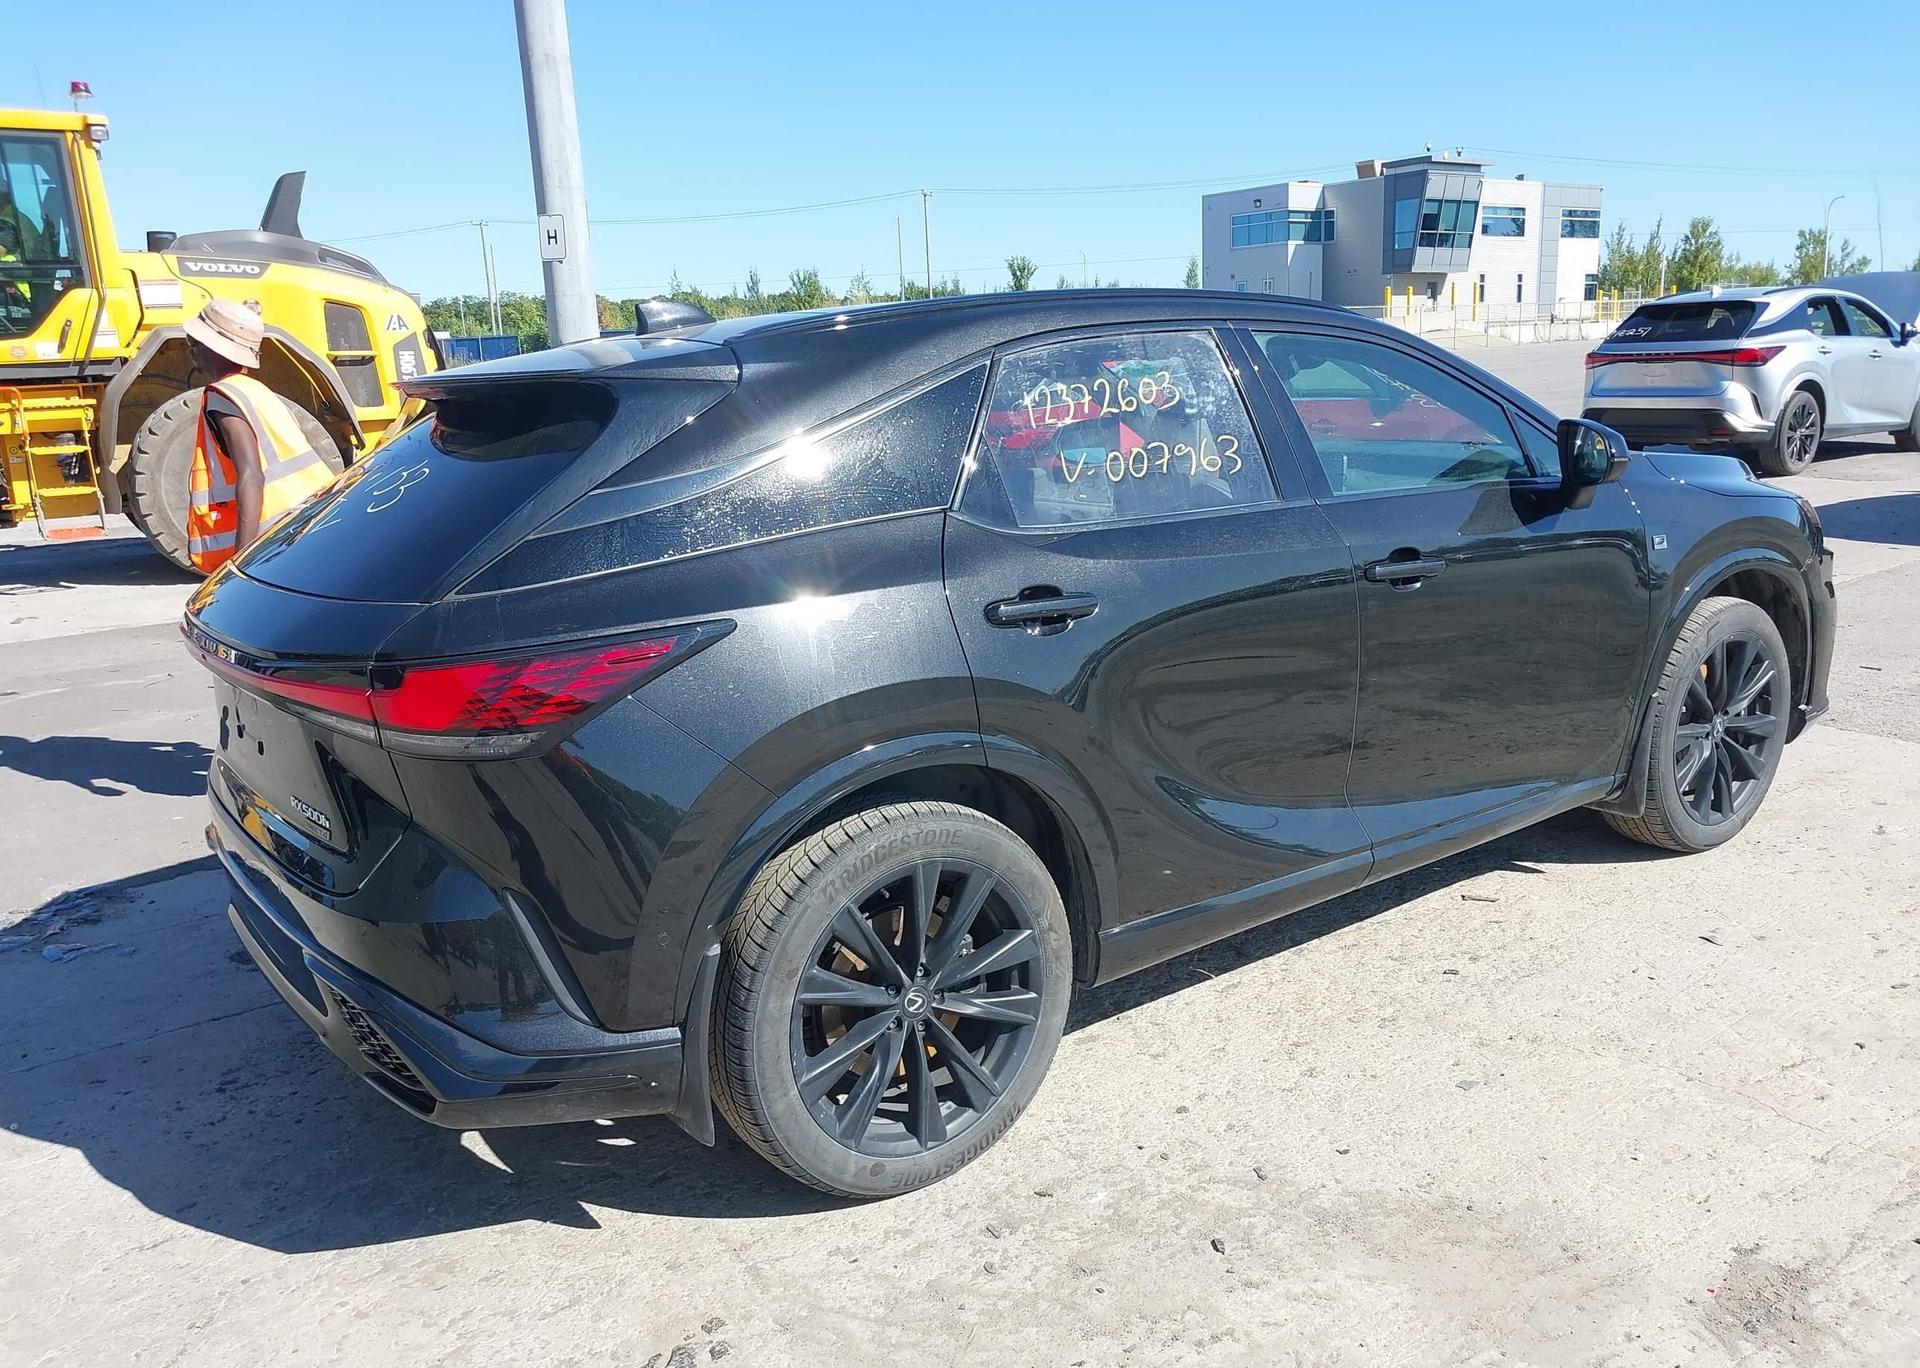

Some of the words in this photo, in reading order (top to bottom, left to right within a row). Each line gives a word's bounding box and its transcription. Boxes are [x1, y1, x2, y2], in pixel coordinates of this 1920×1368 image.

[547, 229, 558, 245] H
[184, 261, 261, 274] VOLVO
[1019, 370, 1182, 429] 12372603
[822, 827, 964, 901] BRIDGESTONE
